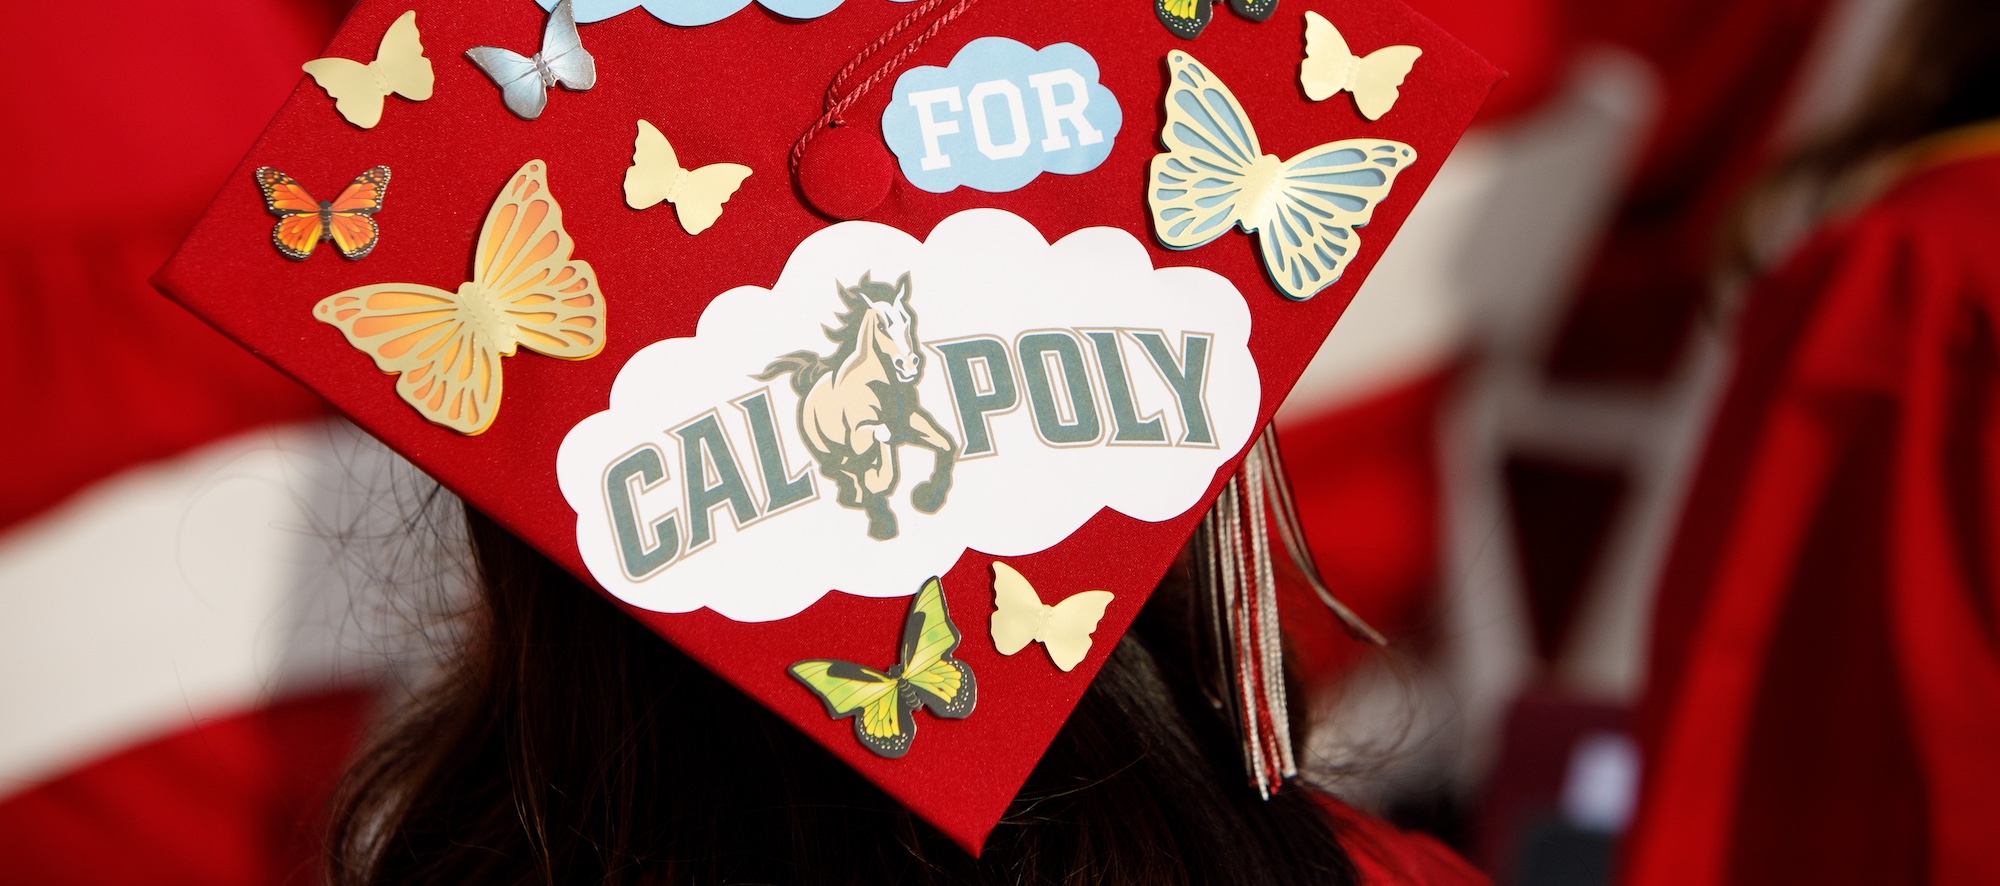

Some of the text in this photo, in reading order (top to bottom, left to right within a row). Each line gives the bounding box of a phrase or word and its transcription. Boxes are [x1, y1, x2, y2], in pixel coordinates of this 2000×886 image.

[907, 67, 1104, 171] FOR
[602, 326, 1220, 583] CAL POLY
